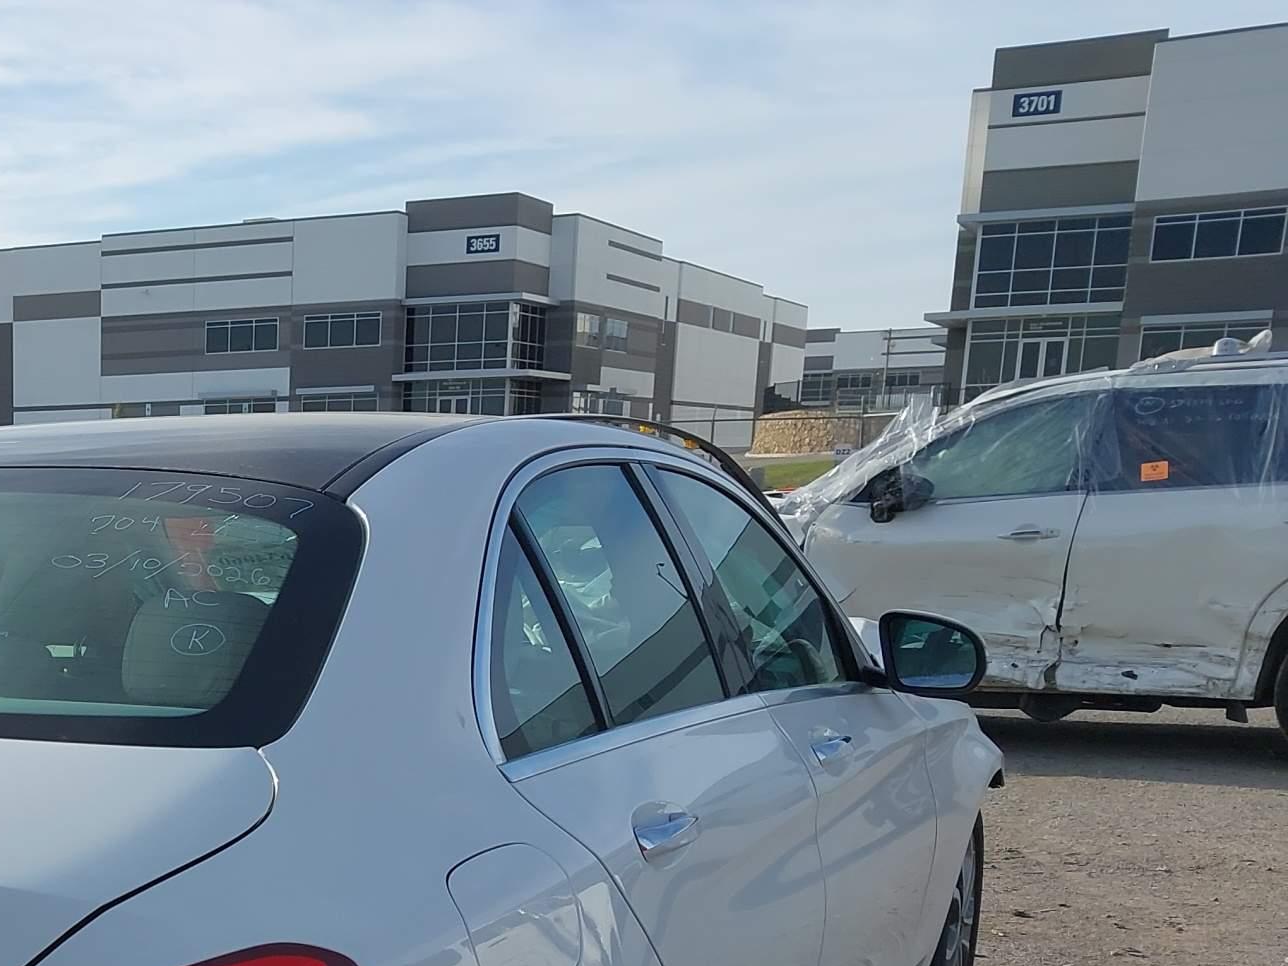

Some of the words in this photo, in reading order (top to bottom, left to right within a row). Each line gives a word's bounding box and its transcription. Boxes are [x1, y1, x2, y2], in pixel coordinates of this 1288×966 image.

[1018, 94, 1056, 113] 3701
[470, 237, 497, 251] 3655
[119, 481, 314, 519] 179507
[164, 588, 220, 607] AC
[188, 629, 209, 650] K
